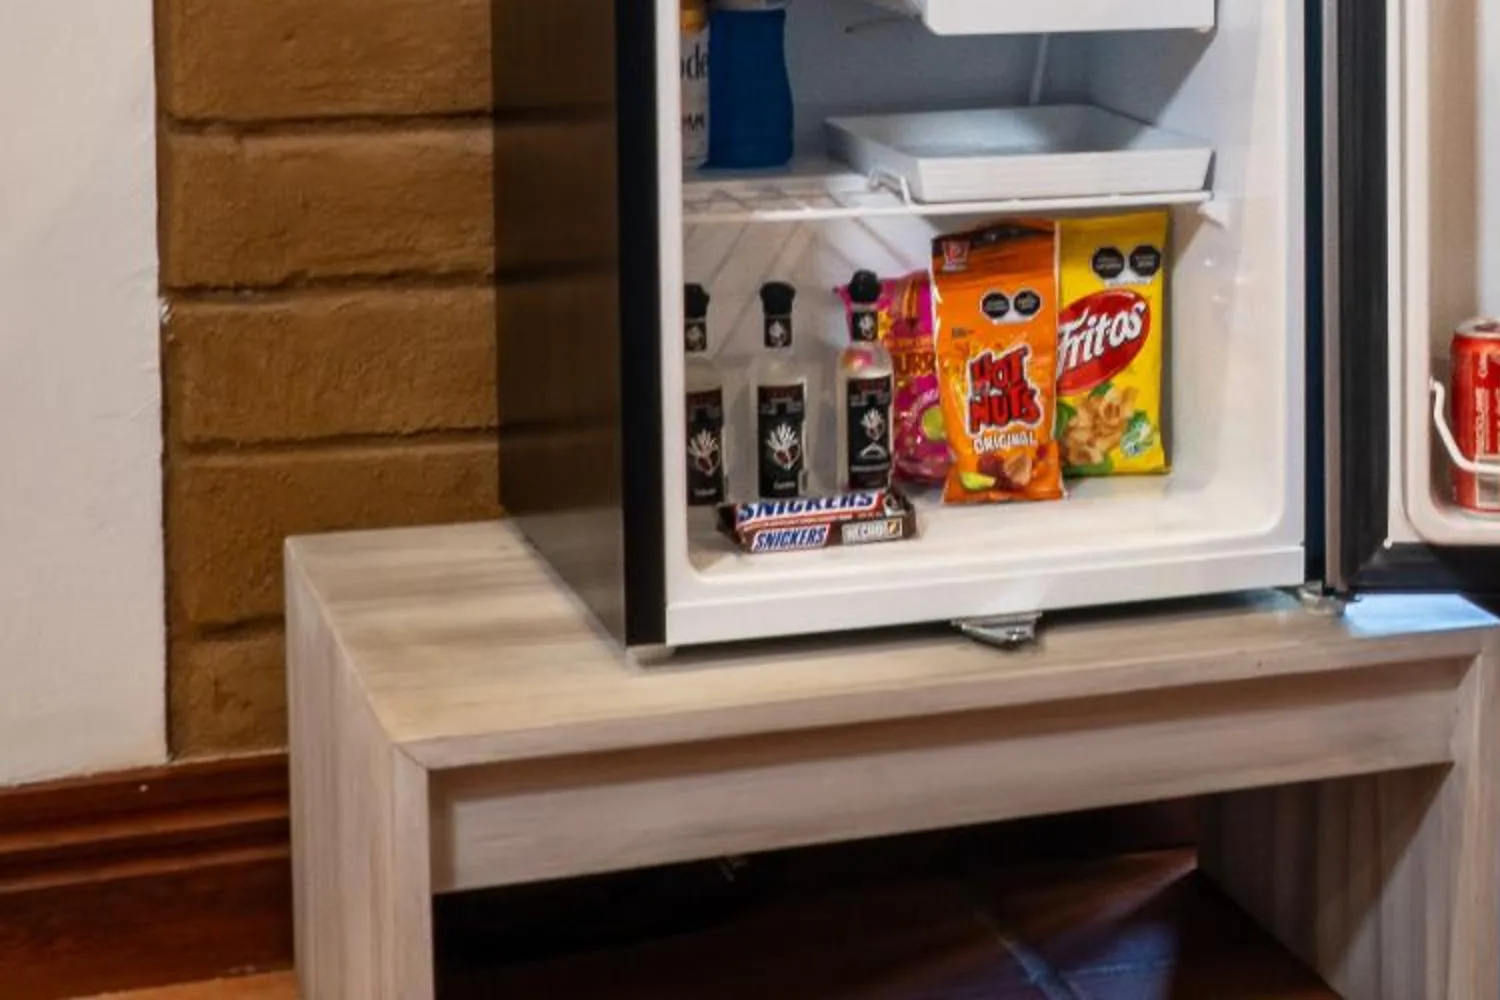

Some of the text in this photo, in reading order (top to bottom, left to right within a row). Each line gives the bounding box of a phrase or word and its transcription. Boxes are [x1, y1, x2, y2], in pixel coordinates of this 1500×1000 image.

[969, 347, 1029, 391] HOT
[969, 384, 1041, 434] NUTS
[974, 431, 1037, 453] ORIGINAL
[737, 492, 872, 523] SNICKERS
[754, 526, 827, 549] SNICKERS
